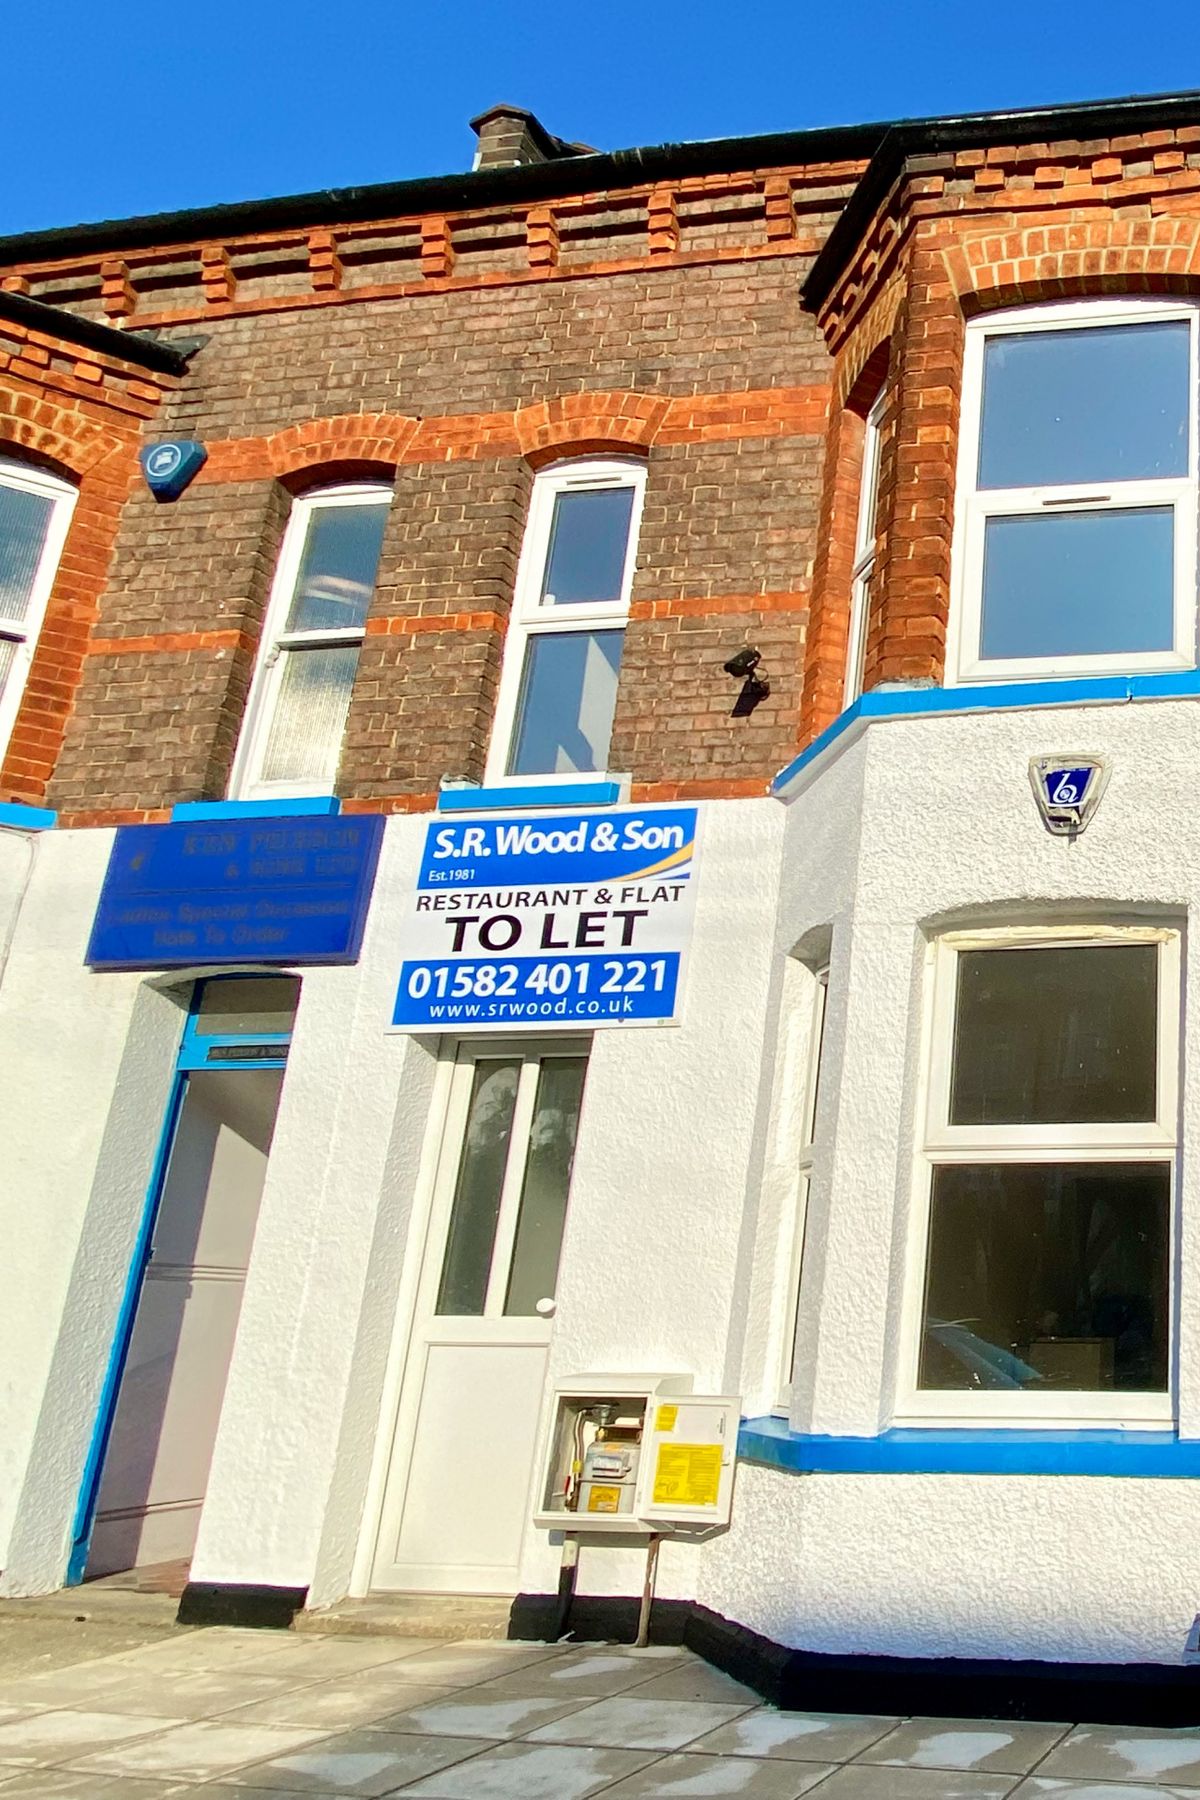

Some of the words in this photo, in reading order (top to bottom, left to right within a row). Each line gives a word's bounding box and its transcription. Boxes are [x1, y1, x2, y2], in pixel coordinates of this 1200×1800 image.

[433, 827, 491, 859] S.R.
[496, 821, 588, 855] Wood
[590, 821, 619, 852] &
[622, 820, 684, 851] Son
[416, 889, 588, 911] RESTAURANT
[594, 888, 613, 905] &
[620, 885, 685, 904] FLAT
[445, 914, 523, 952] TO
[540, 910, 649, 949] LET
[408, 964, 518, 999] 01582
[525, 962, 590, 995] 401
[600, 959, 666, 993] 221
[430, 995, 634, 1018] www.srwood.co.uk
